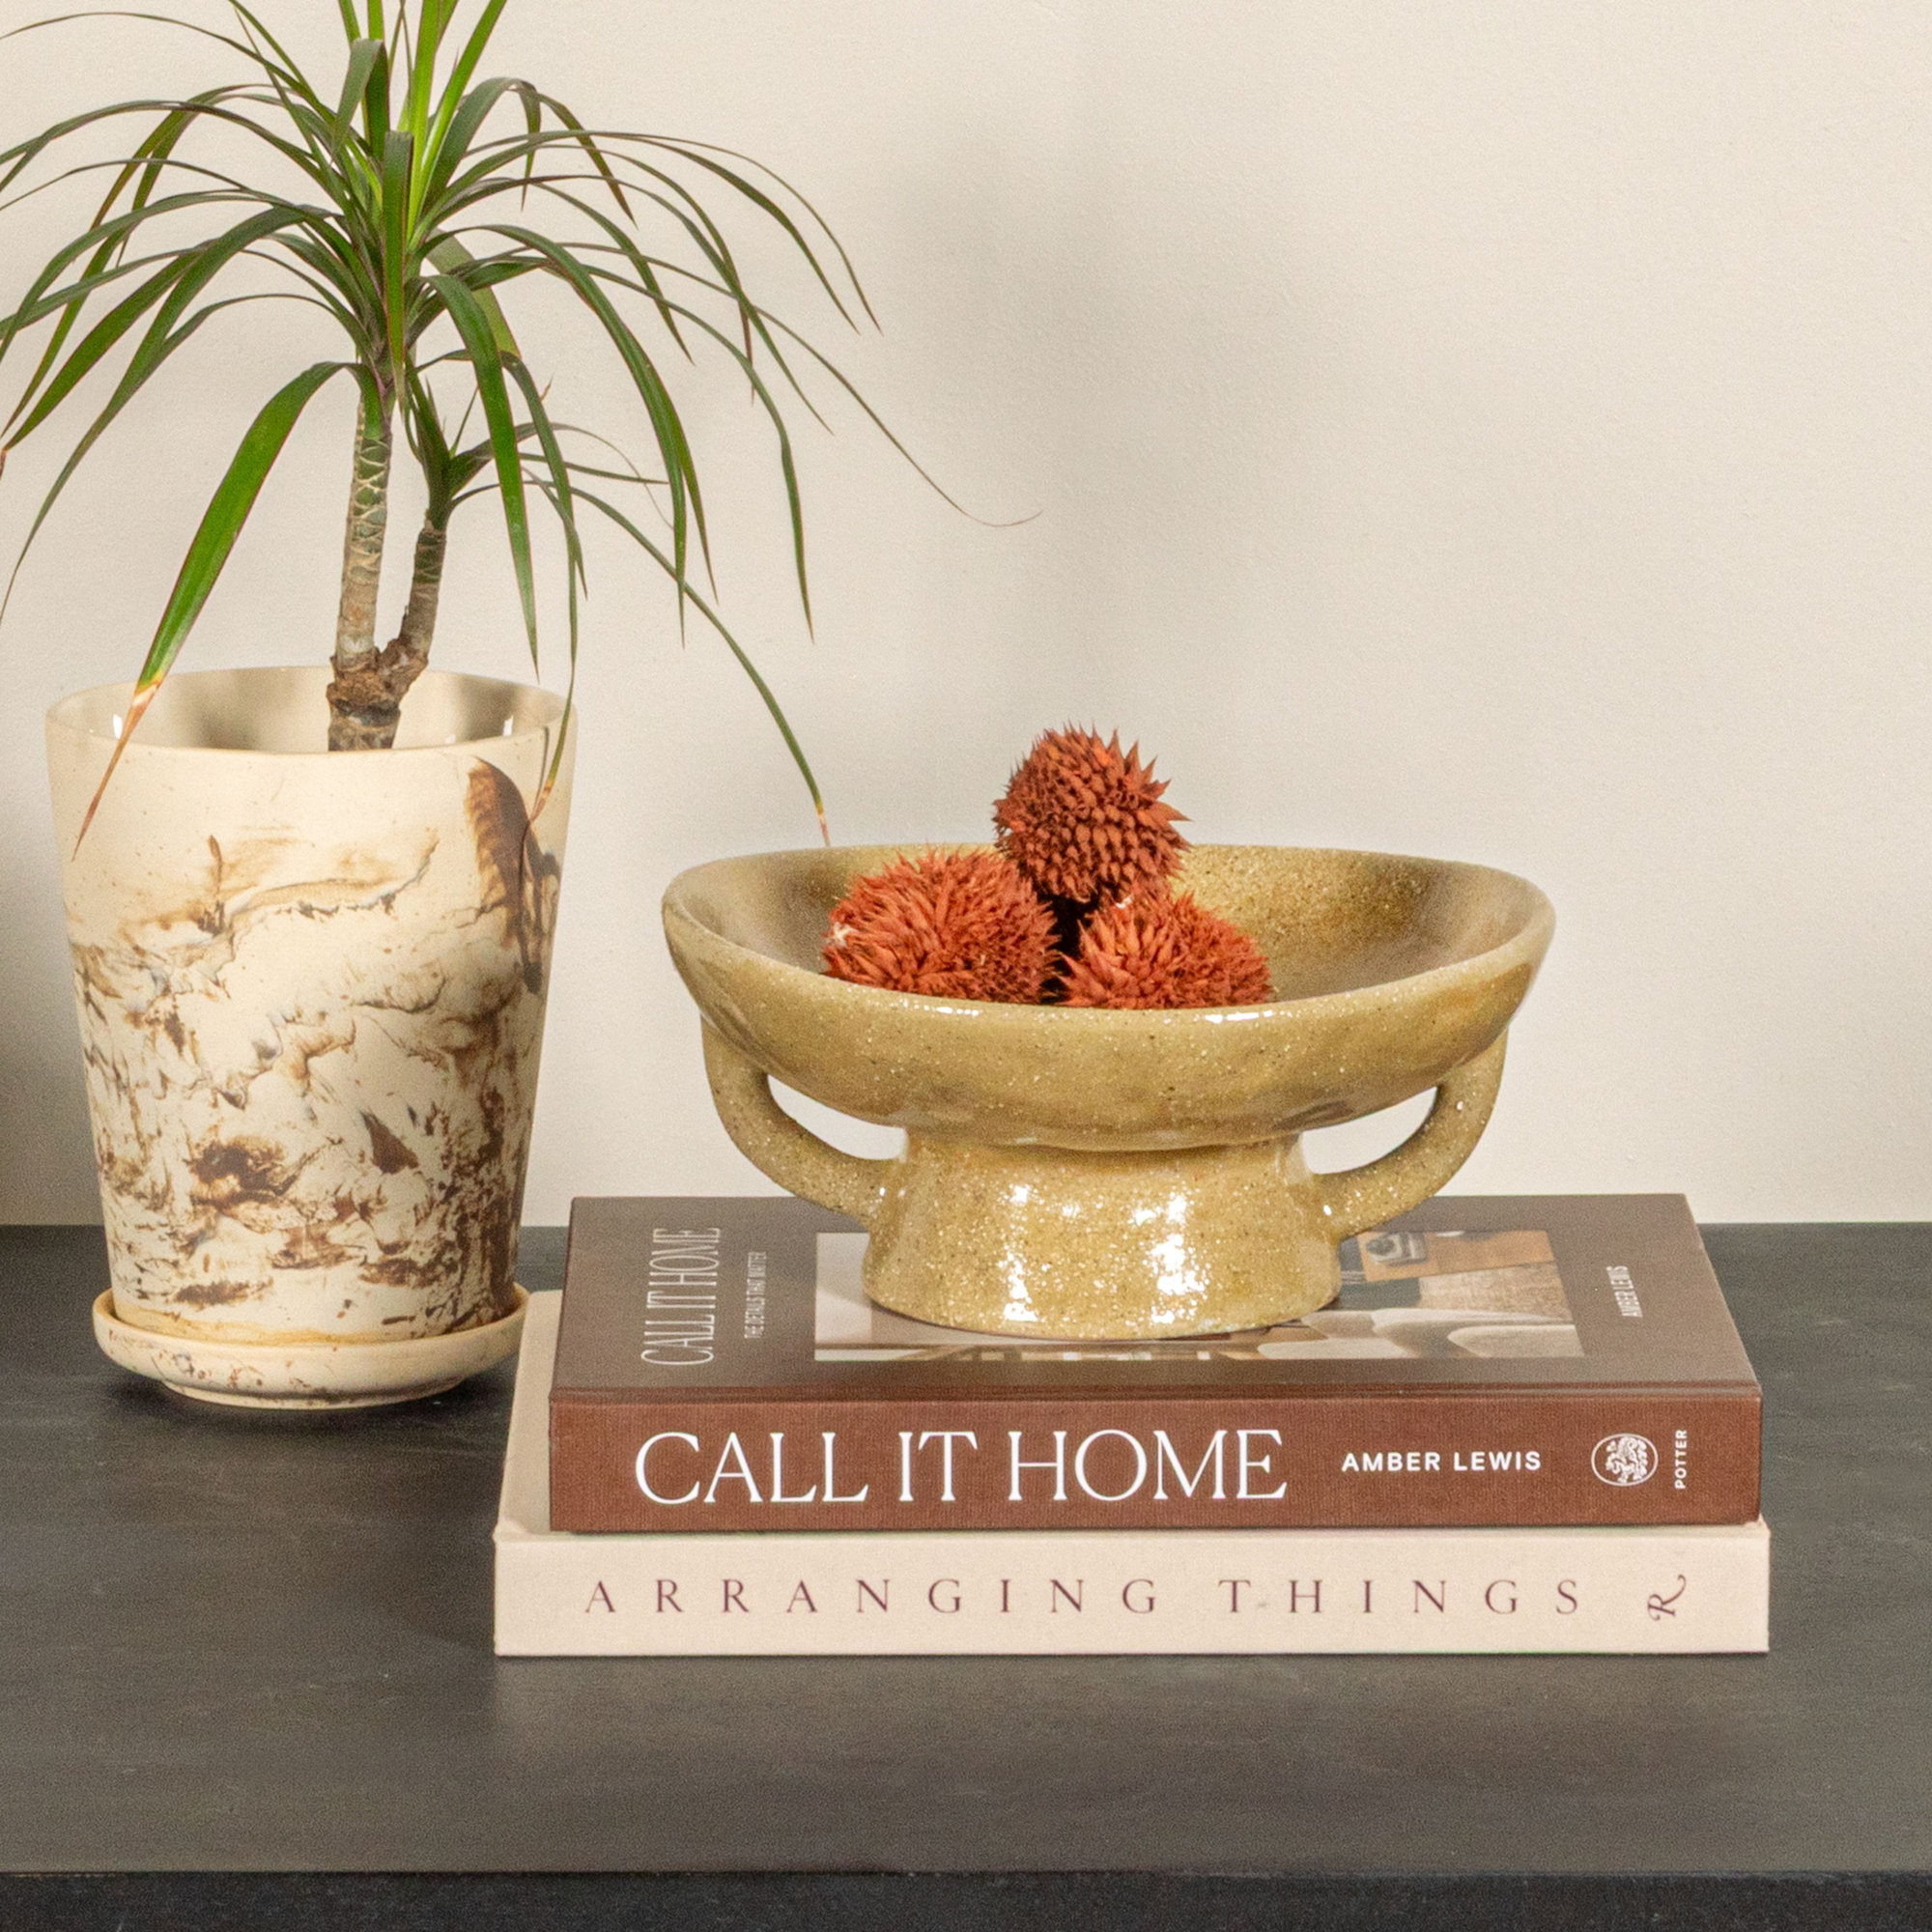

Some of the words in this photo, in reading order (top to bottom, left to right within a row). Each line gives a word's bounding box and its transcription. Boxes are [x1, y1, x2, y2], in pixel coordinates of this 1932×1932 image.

[648, 1228, 721, 1286] HOME
[646, 1291, 716, 1309] IT
[640, 1315, 715, 1365] CALL
[635, 1431, 869, 1505] CALL
[897, 1431, 979, 1502] IT
[1008, 1429, 1288, 1501] HOME
[1341, 1452, 1441, 1472] AMBER
[1453, 1451, 1542, 1472] LEWIS
[1674, 1429, 1688, 1490] POTTER
[584, 1578, 1157, 1614] ARRANGING
[1217, 1578, 1579, 1614] THINGS
